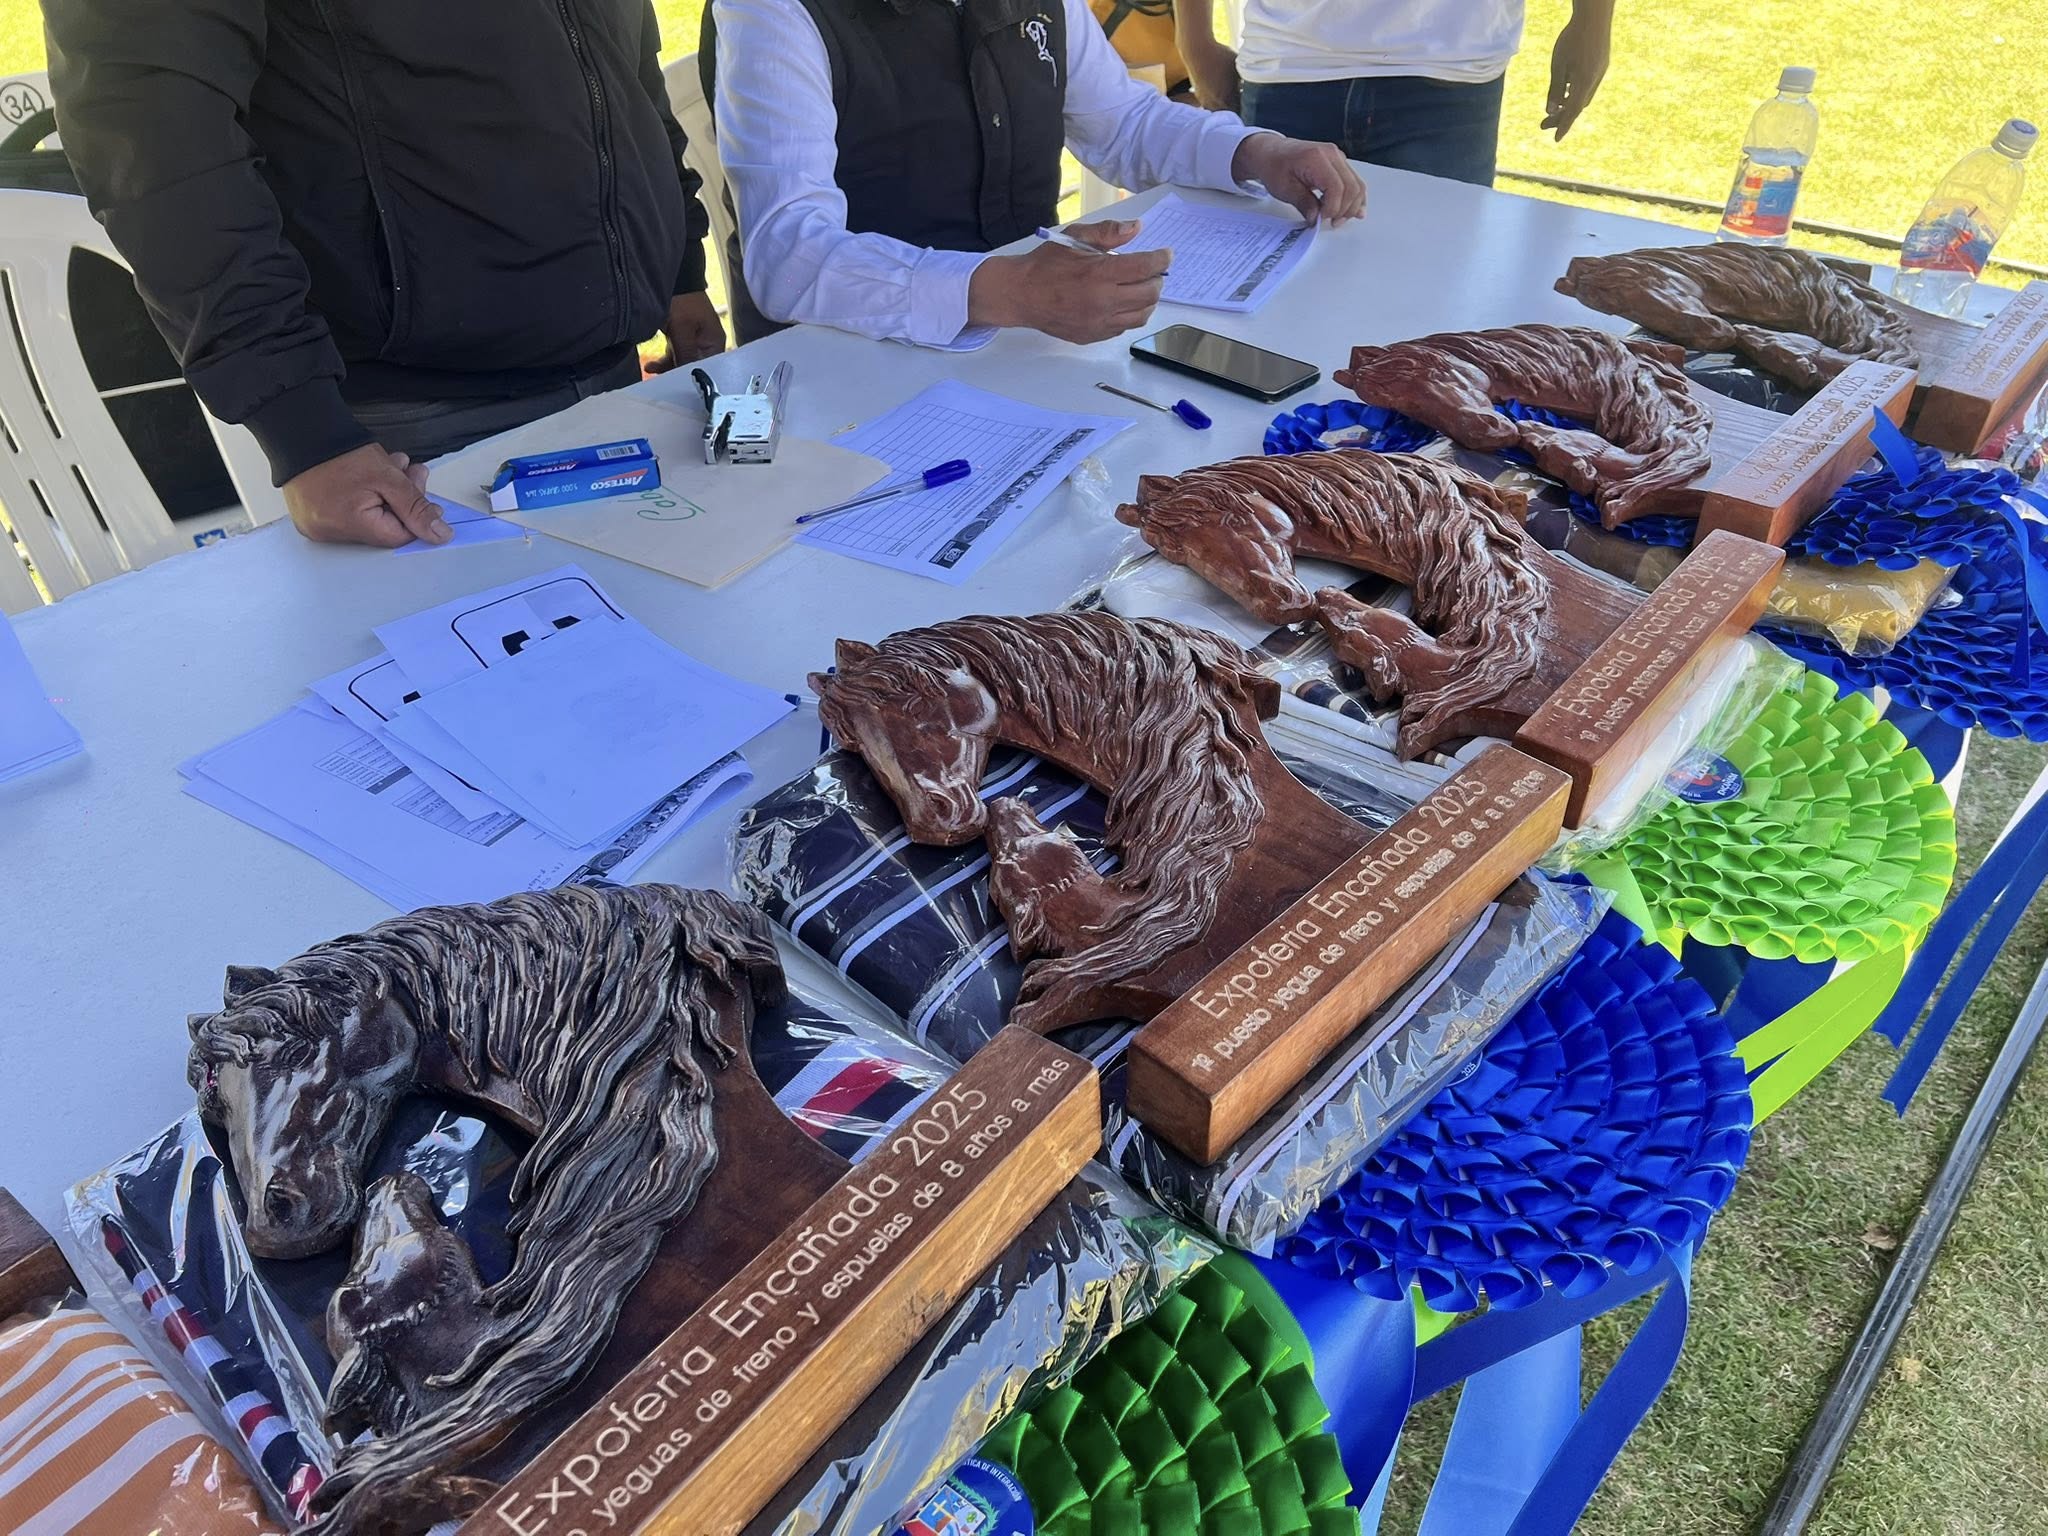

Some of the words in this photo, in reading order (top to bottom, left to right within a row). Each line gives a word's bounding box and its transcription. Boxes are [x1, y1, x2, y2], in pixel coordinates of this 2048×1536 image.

[5, 90, 37, 119] 34
[2013, 292, 2045, 310] 2025
[1829, 375, 1867, 397] 2025
[1861, 393, 1880, 401] 2
[1855, 400, 1872, 409] de
[591, 475, 644, 491] ARTESCO
[1701, 600, 1721, 613] de
[1554, 649, 1638, 717] Expoferia
[1618, 587, 1697, 650] Encañada
[1679, 553, 1726, 587] 2025
[1676, 613, 1708, 639] bozal
[1670, 636, 1687, 651] al
[1627, 648, 1676, 699] potrancas
[1594, 697, 1634, 733] puesto
[1510, 769, 1546, 798] años
[1493, 795, 1516, 809] 8
[1470, 817, 1490, 831] 4
[1485, 808, 1504, 821] a
[1451, 830, 1477, 849] de
[1394, 847, 1457, 899] espuelas
[1189, 918, 1323, 1020] Expoferia
[1307, 827, 1433, 919] Encañada
[1418, 774, 1488, 828] 2025
[1379, 897, 1400, 914] y
[1339, 910, 1384, 944] freno
[1318, 943, 1346, 965] de
[1267, 964, 1324, 1011] yegua
[1213, 1007, 1272, 1060] puesto
[591, 1427, 693, 1527] yeguas
[696, 1388, 732, 1423] de
[732, 1325, 797, 1383] freno
[797, 1302, 821, 1325] y
[821, 1212, 914, 1299] espuelas
[912, 1181, 945, 1209] de
[940, 1159, 965, 1178] 8
[964, 1114, 1013, 1159] años
[1011, 1098, 1031, 1113] a
[1027, 1058, 1070, 1096] más
[495, 1345, 718, 1536] Expoferia
[708, 1173, 900, 1338] Encañada
[891, 1081, 987, 1167] 2025
[981, 1461, 990, 1472] DE
